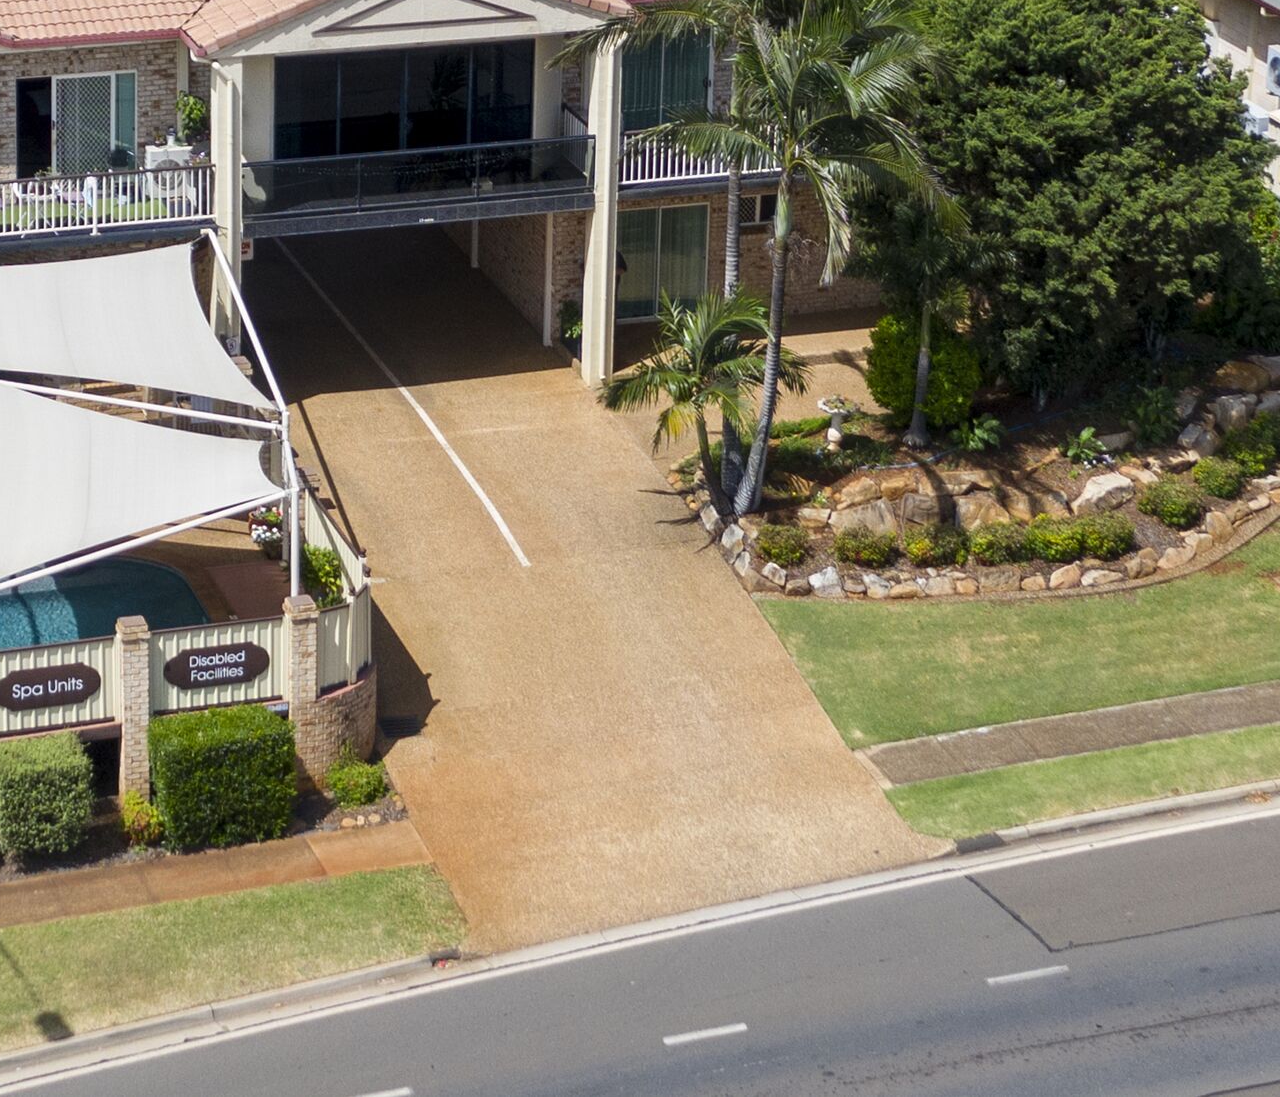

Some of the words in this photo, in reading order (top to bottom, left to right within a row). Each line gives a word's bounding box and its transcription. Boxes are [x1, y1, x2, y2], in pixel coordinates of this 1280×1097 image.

[189, 650, 246, 668] Disabled
[190, 666, 244, 682] Facilities
[12, 683, 43, 700] Spa
[47, 677, 84, 693] Units
